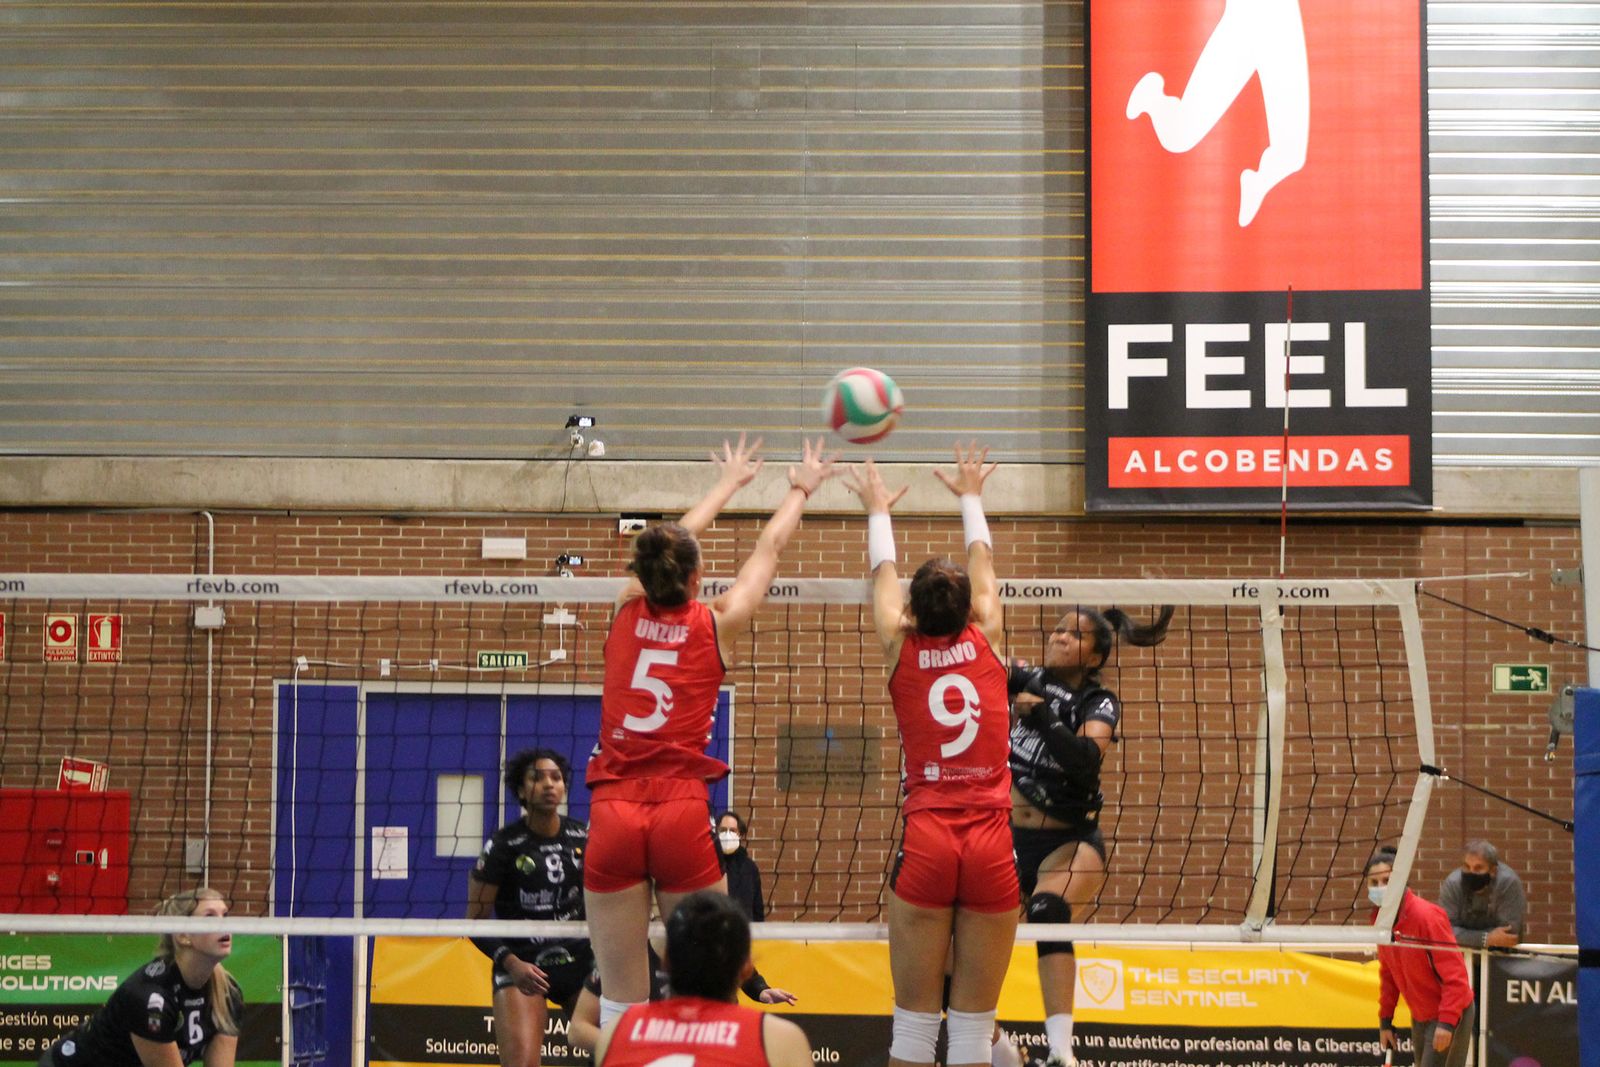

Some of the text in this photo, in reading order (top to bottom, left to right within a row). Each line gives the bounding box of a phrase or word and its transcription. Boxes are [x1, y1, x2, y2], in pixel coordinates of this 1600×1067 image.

[1108, 322, 1408, 409] FEEL
[1124, 448, 1393, 474] ALCOBENDAS
[187, 578, 280, 594] rfevb.com
[445, 580, 538, 595] rfevb.com
[1233, 583, 1330, 599] rfe.com
[634, 618, 690, 643] UNZUE
[89, 651, 120, 661] EXTINTOR
[481, 654, 523, 667] SALIDA
[918, 641, 977, 670] BRAVO
[623, 648, 678, 733] 5
[928, 673, 982, 759] 9
[545, 853, 565, 884] 8
[0, 955, 52, 970] IGES
[0, 975, 118, 991] OLUTIONS
[1128, 968, 1311, 985] THE SECURITY
[1130, 990, 1259, 1008] SENTINEL
[1506, 980, 1578, 1004] EN AL
[53, 1014, 80, 1029] que
[188, 1010, 204, 1045] 6
[18, 1037, 36, 1051] se
[1085, 1034, 1105, 1048] un
[1109, 1033, 1181, 1050] auténtico
[1184, 1036, 1270, 1054] profesional
[1274, 1036, 1293, 1052] de
[1297, 1037, 1312, 1052] la
